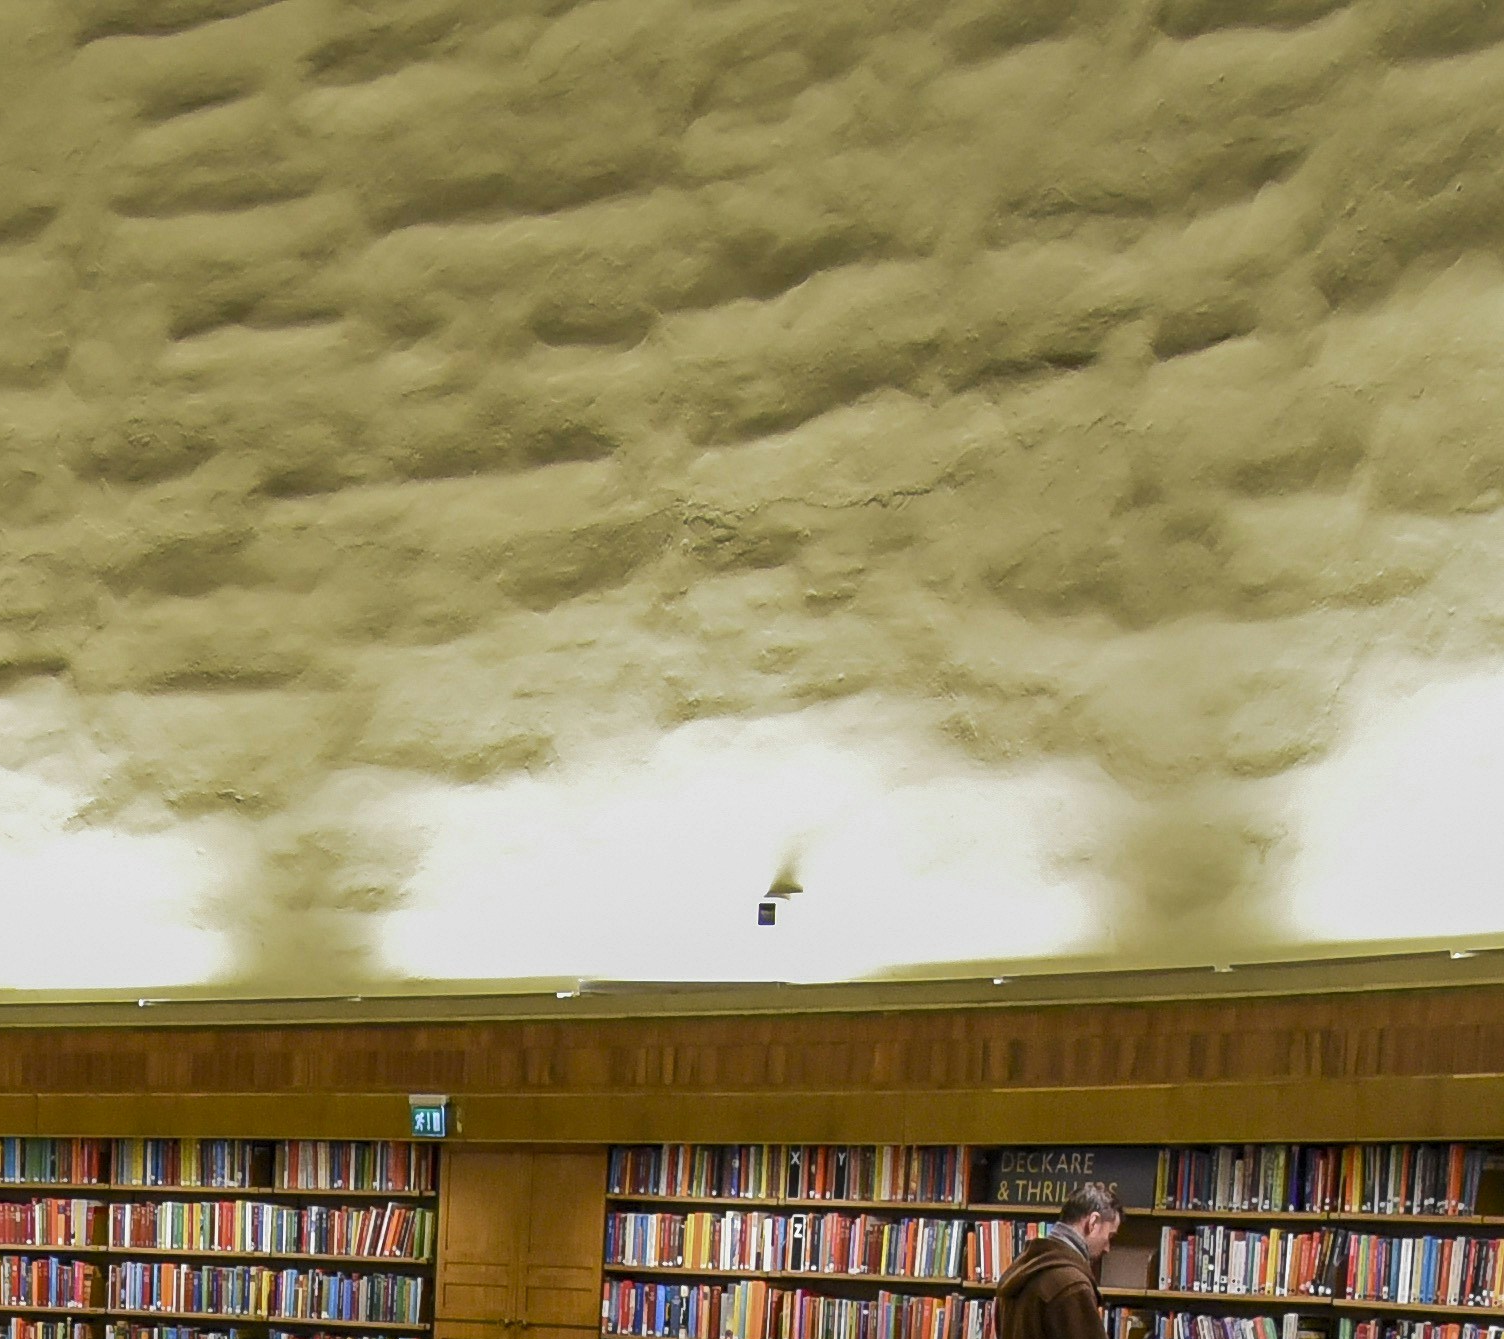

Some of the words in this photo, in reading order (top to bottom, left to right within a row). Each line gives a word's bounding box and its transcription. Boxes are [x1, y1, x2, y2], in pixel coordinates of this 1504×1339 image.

[791, 1151, 800, 1165] X
[838, 1152, 847, 1165] Y
[1001, 1151, 1095, 1175] DECKARE
[997, 1180, 1010, 1201] &
[794, 1223, 803, 1239] Z
